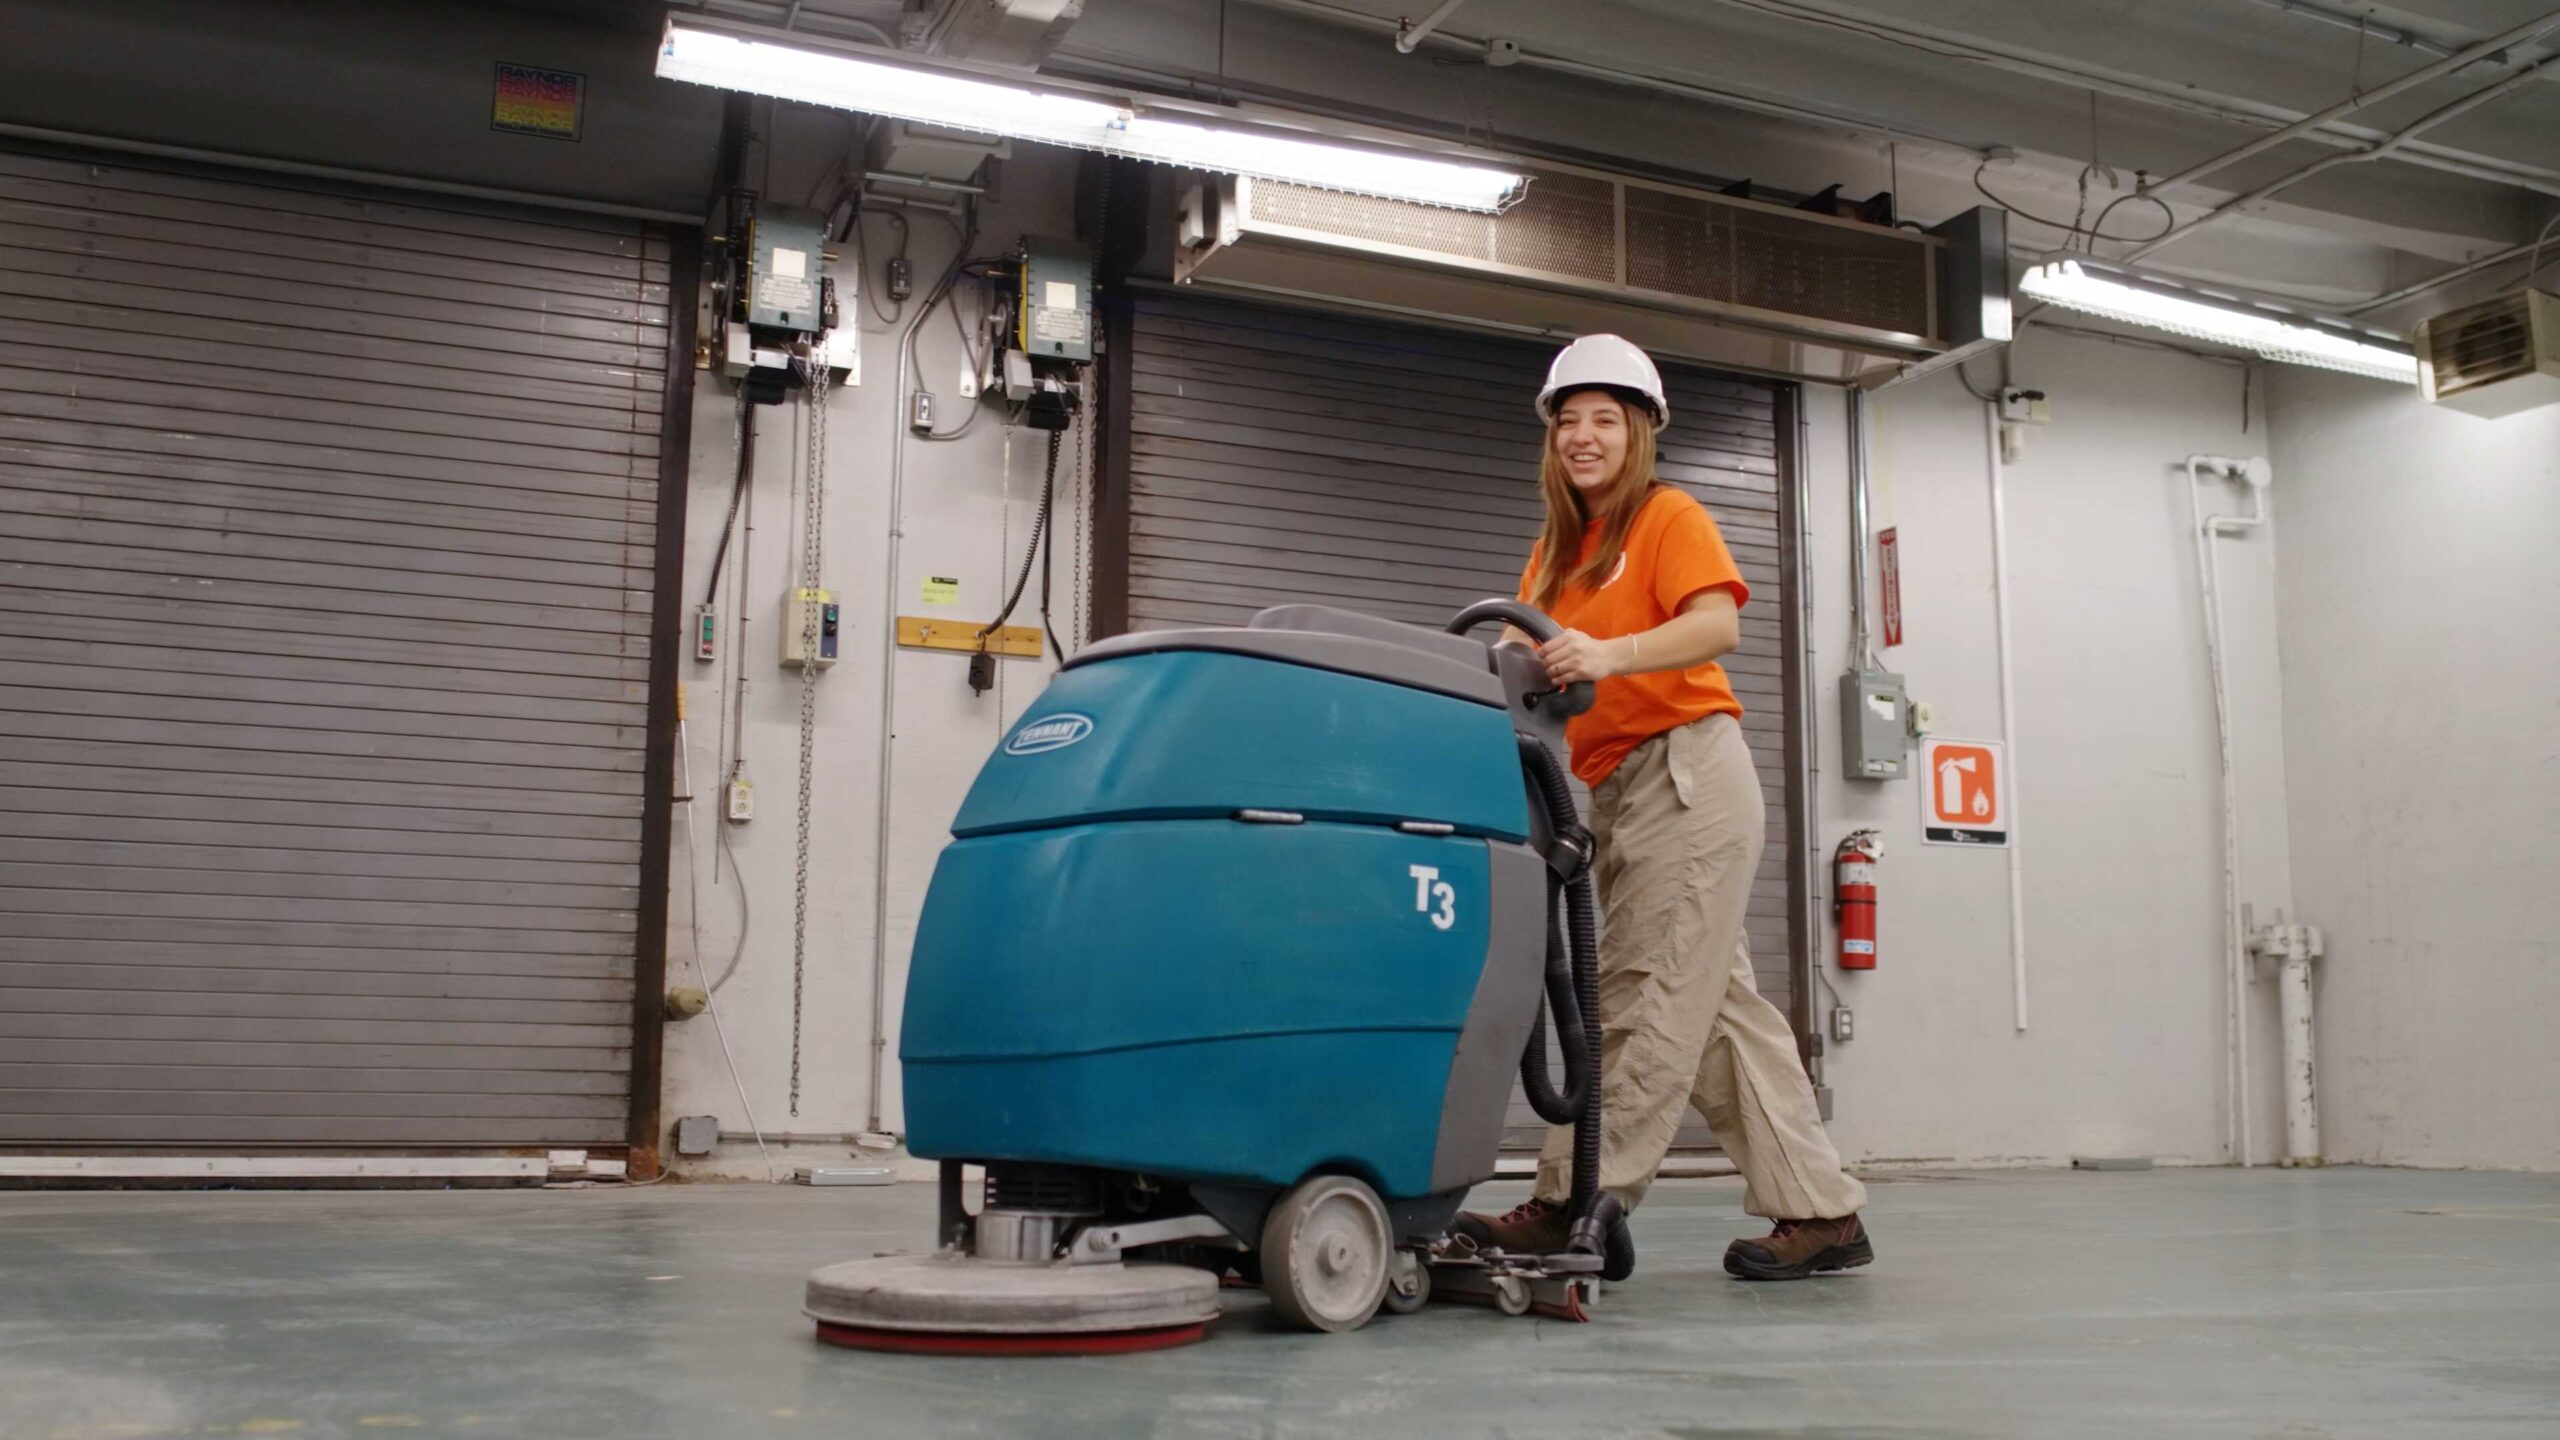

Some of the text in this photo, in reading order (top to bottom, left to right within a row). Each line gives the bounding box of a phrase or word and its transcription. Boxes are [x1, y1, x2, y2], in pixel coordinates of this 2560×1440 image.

[500, 66, 577, 85] RAYNOR
[495, 111, 574, 131] RAYNOR
[1013, 721, 1083, 748] TENNANT
[1409, 864, 1456, 930] T3
